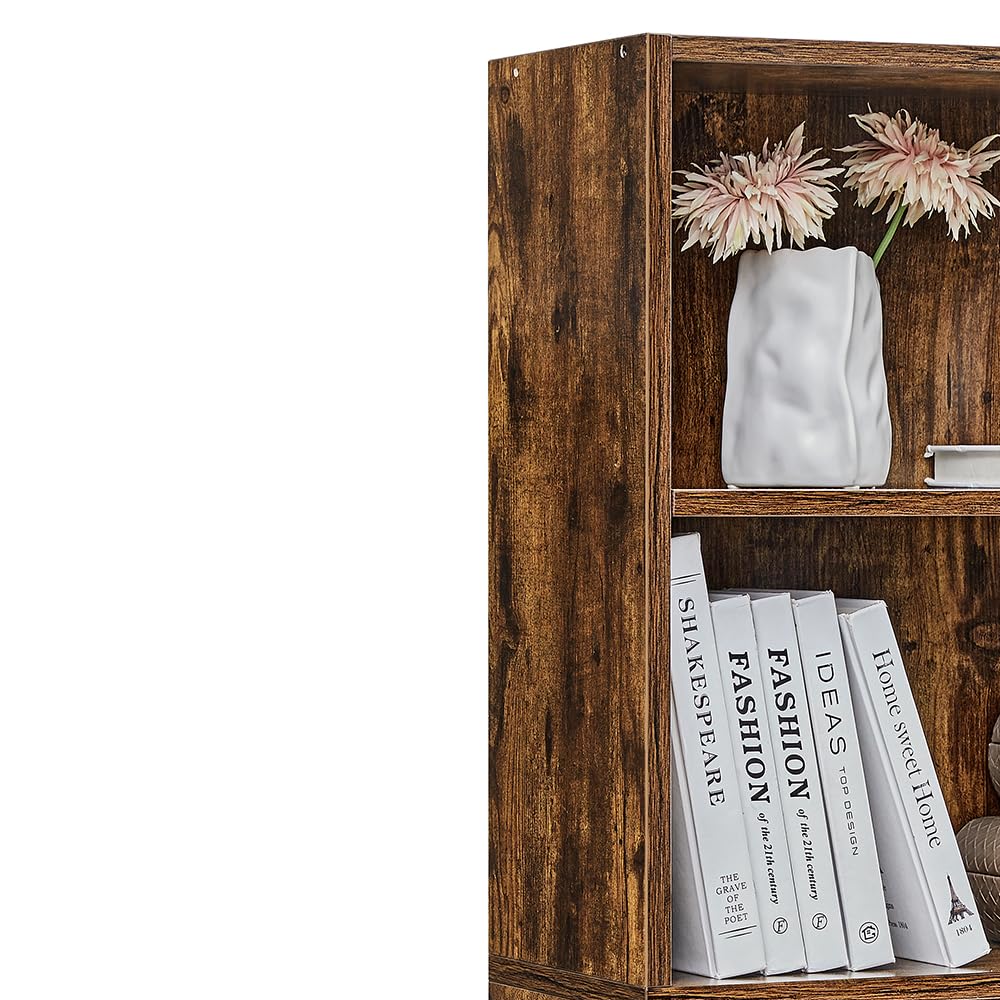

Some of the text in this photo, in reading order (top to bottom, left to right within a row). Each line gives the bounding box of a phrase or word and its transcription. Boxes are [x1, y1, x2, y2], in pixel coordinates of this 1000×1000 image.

[678, 597, 725, 806] SHAKESPEARE
[815, 651, 859, 856] IDEAS TOP DESIGN
[872, 648, 943, 849] Home sweet Home
[728, 651, 779, 905] FASHION of the 21th century
[767, 648, 819, 901] FASHION of the 21th century
[715, 882, 748, 896] GRAVE
[720, 873, 740, 884] THE
[724, 912, 749, 925] POET
[725, 903, 745, 914] THE
[726, 894, 740, 904] OF
